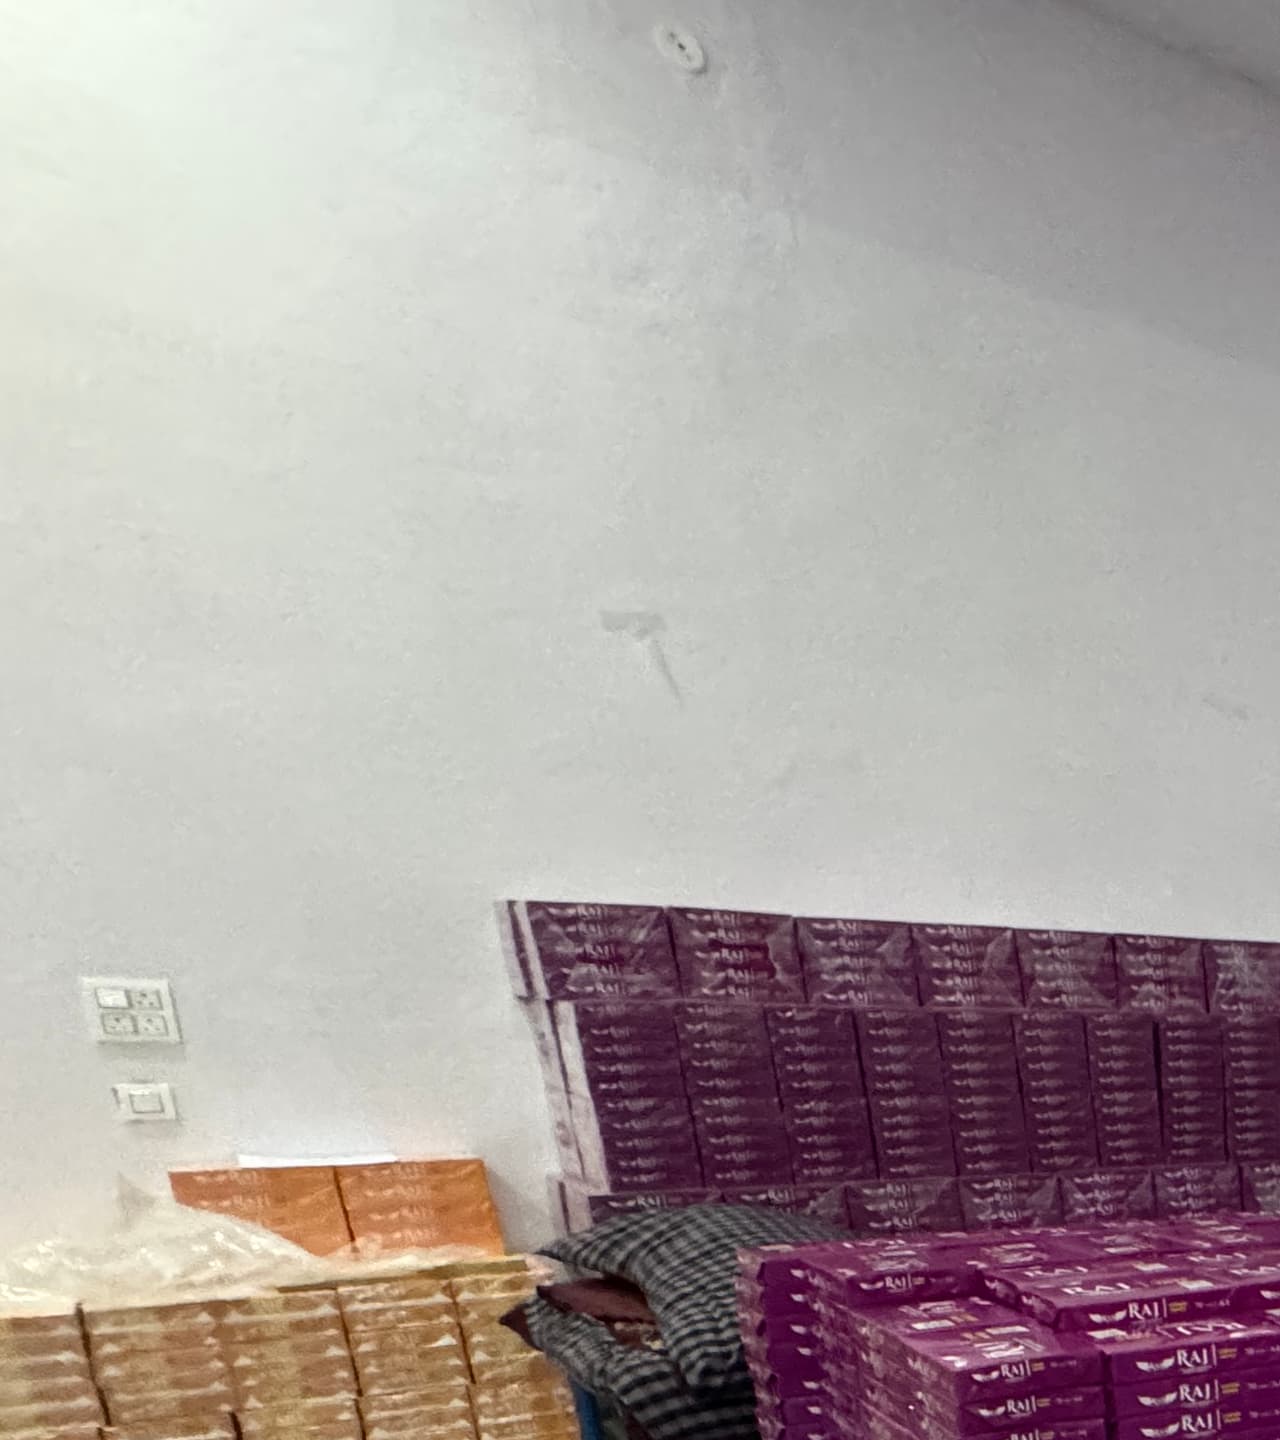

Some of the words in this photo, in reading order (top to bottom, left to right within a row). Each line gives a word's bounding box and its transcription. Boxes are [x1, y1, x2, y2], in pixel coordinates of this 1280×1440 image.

[1178, 1349, 1209, 1365] RAJ
[1001, 1364, 1024, 1378] RAJ
[1179, 1384, 1211, 1400] RAJ
